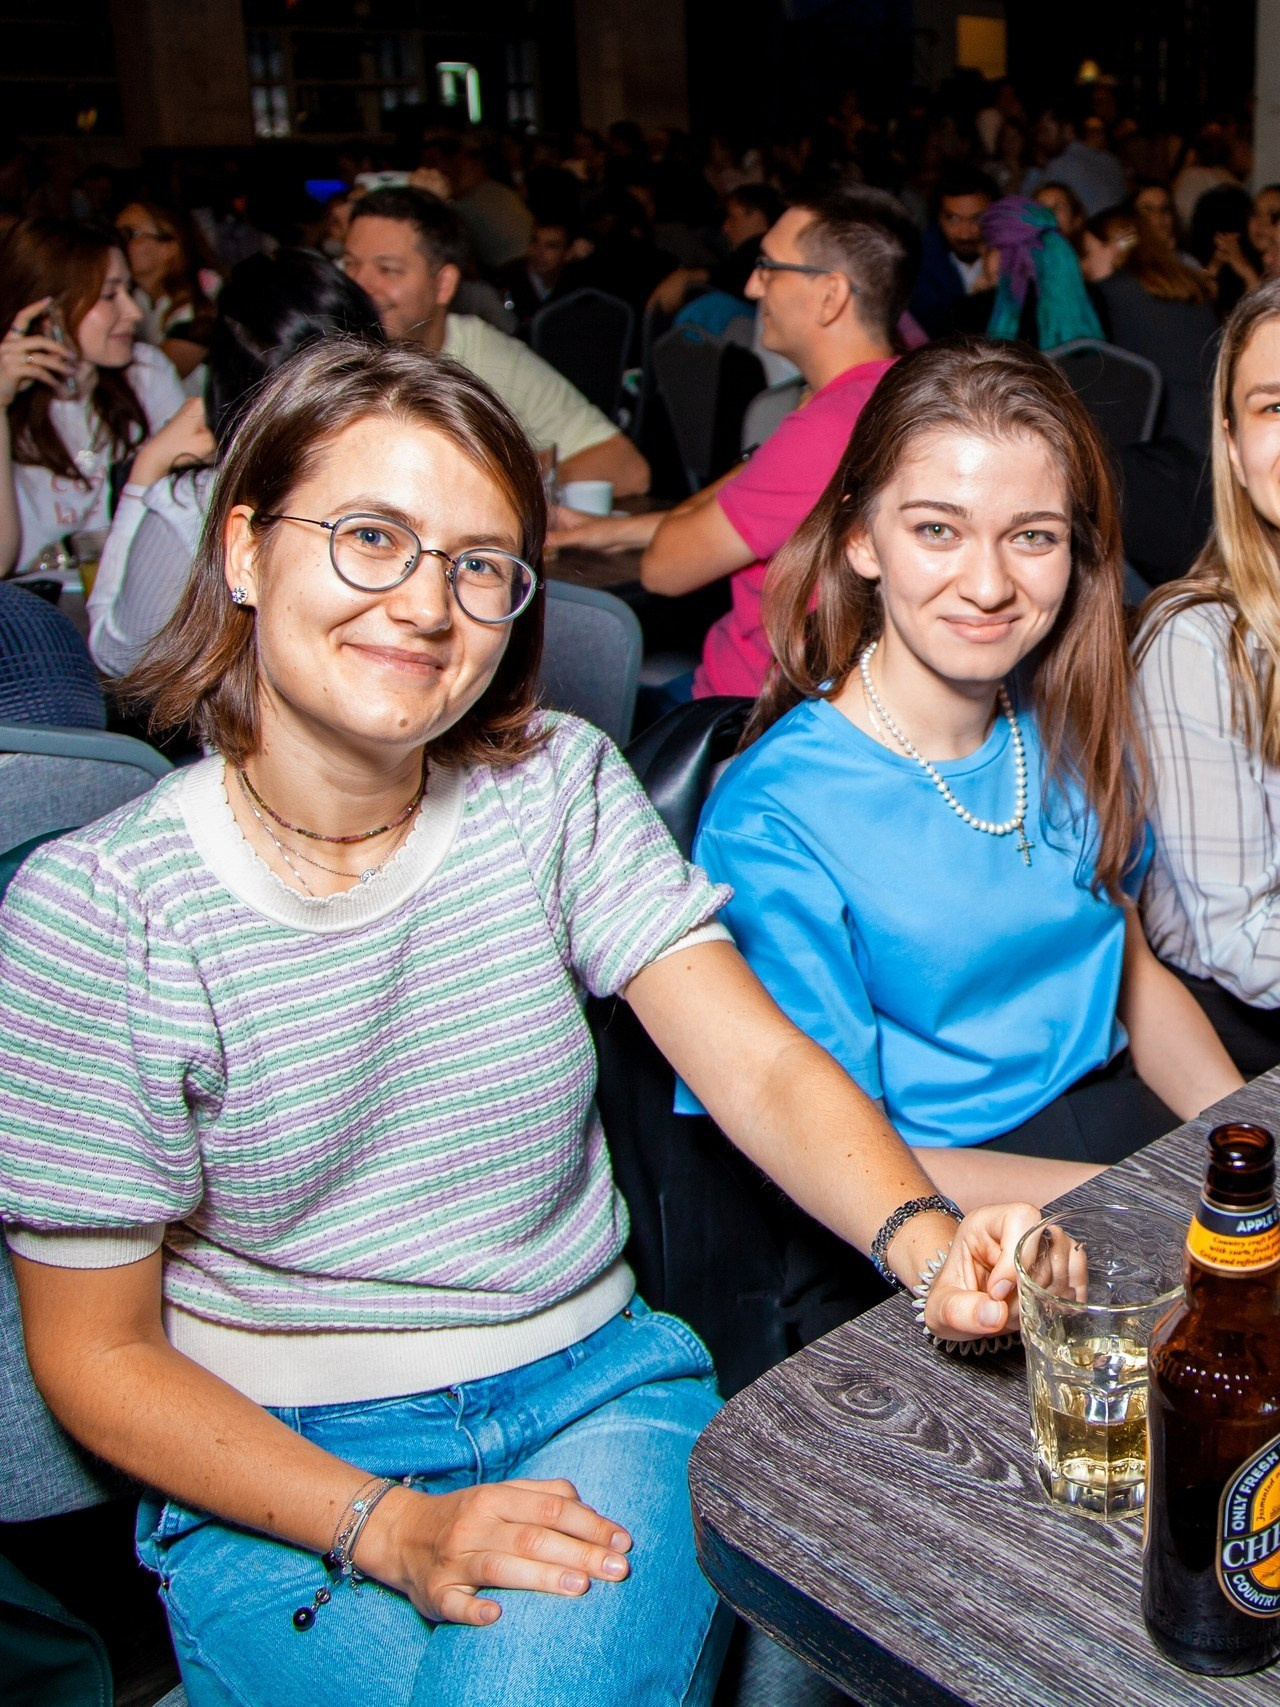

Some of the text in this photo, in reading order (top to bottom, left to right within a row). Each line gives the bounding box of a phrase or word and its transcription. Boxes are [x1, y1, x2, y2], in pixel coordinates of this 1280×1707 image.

[1236, 1214, 1273, 1232] APPLE
[1231, 1494, 1248, 1531] ONLY
[1240, 1451, 1279, 1494] FRESH
[1233, 1574, 1279, 1606] COUNTRY
